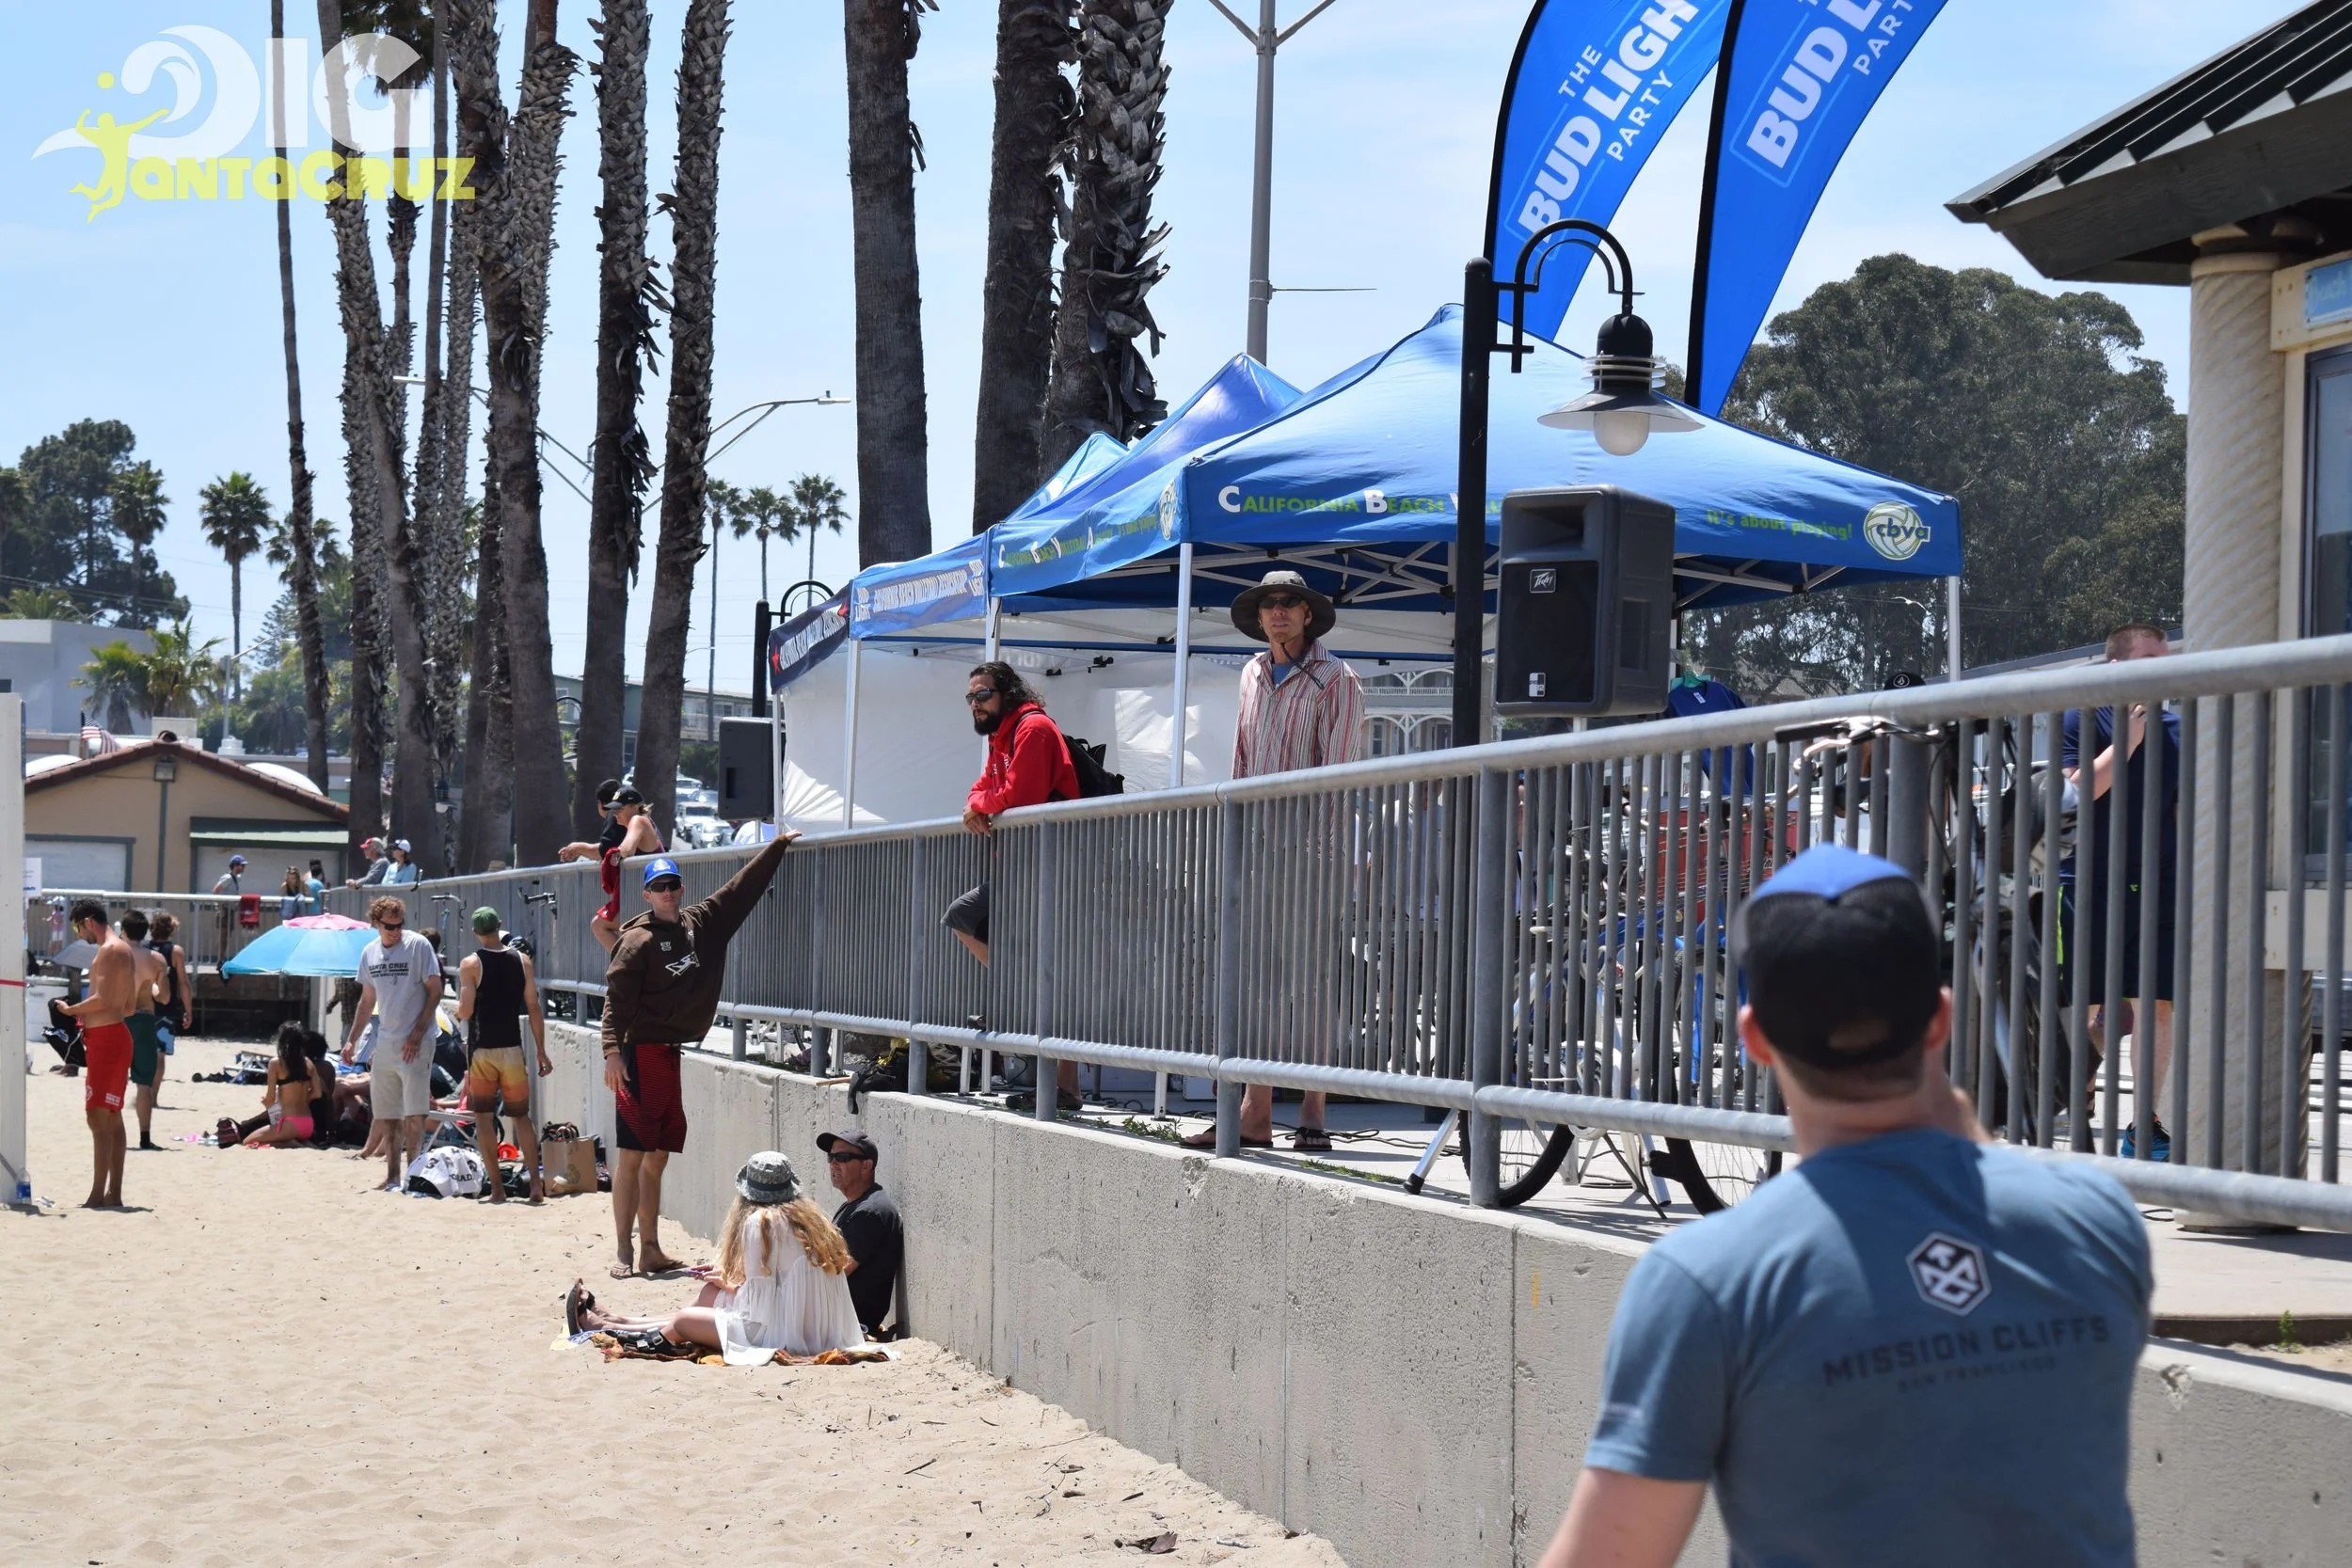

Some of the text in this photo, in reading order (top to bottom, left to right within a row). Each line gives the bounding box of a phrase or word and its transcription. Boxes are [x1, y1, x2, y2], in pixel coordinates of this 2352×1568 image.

[1558, 44, 1601, 101] THE
[1745, 26, 1849, 169] BUD
[1606, 70, 1674, 162] PARTY
[1518, 115, 1601, 245] BUD
[1217, 485, 1360, 514] CALIFORNIA
[1364, 489, 1446, 515] BEACH
[1740, 513, 1786, 531] about
[1822, 1314, 2110, 1386] MISSION CLIFFS
